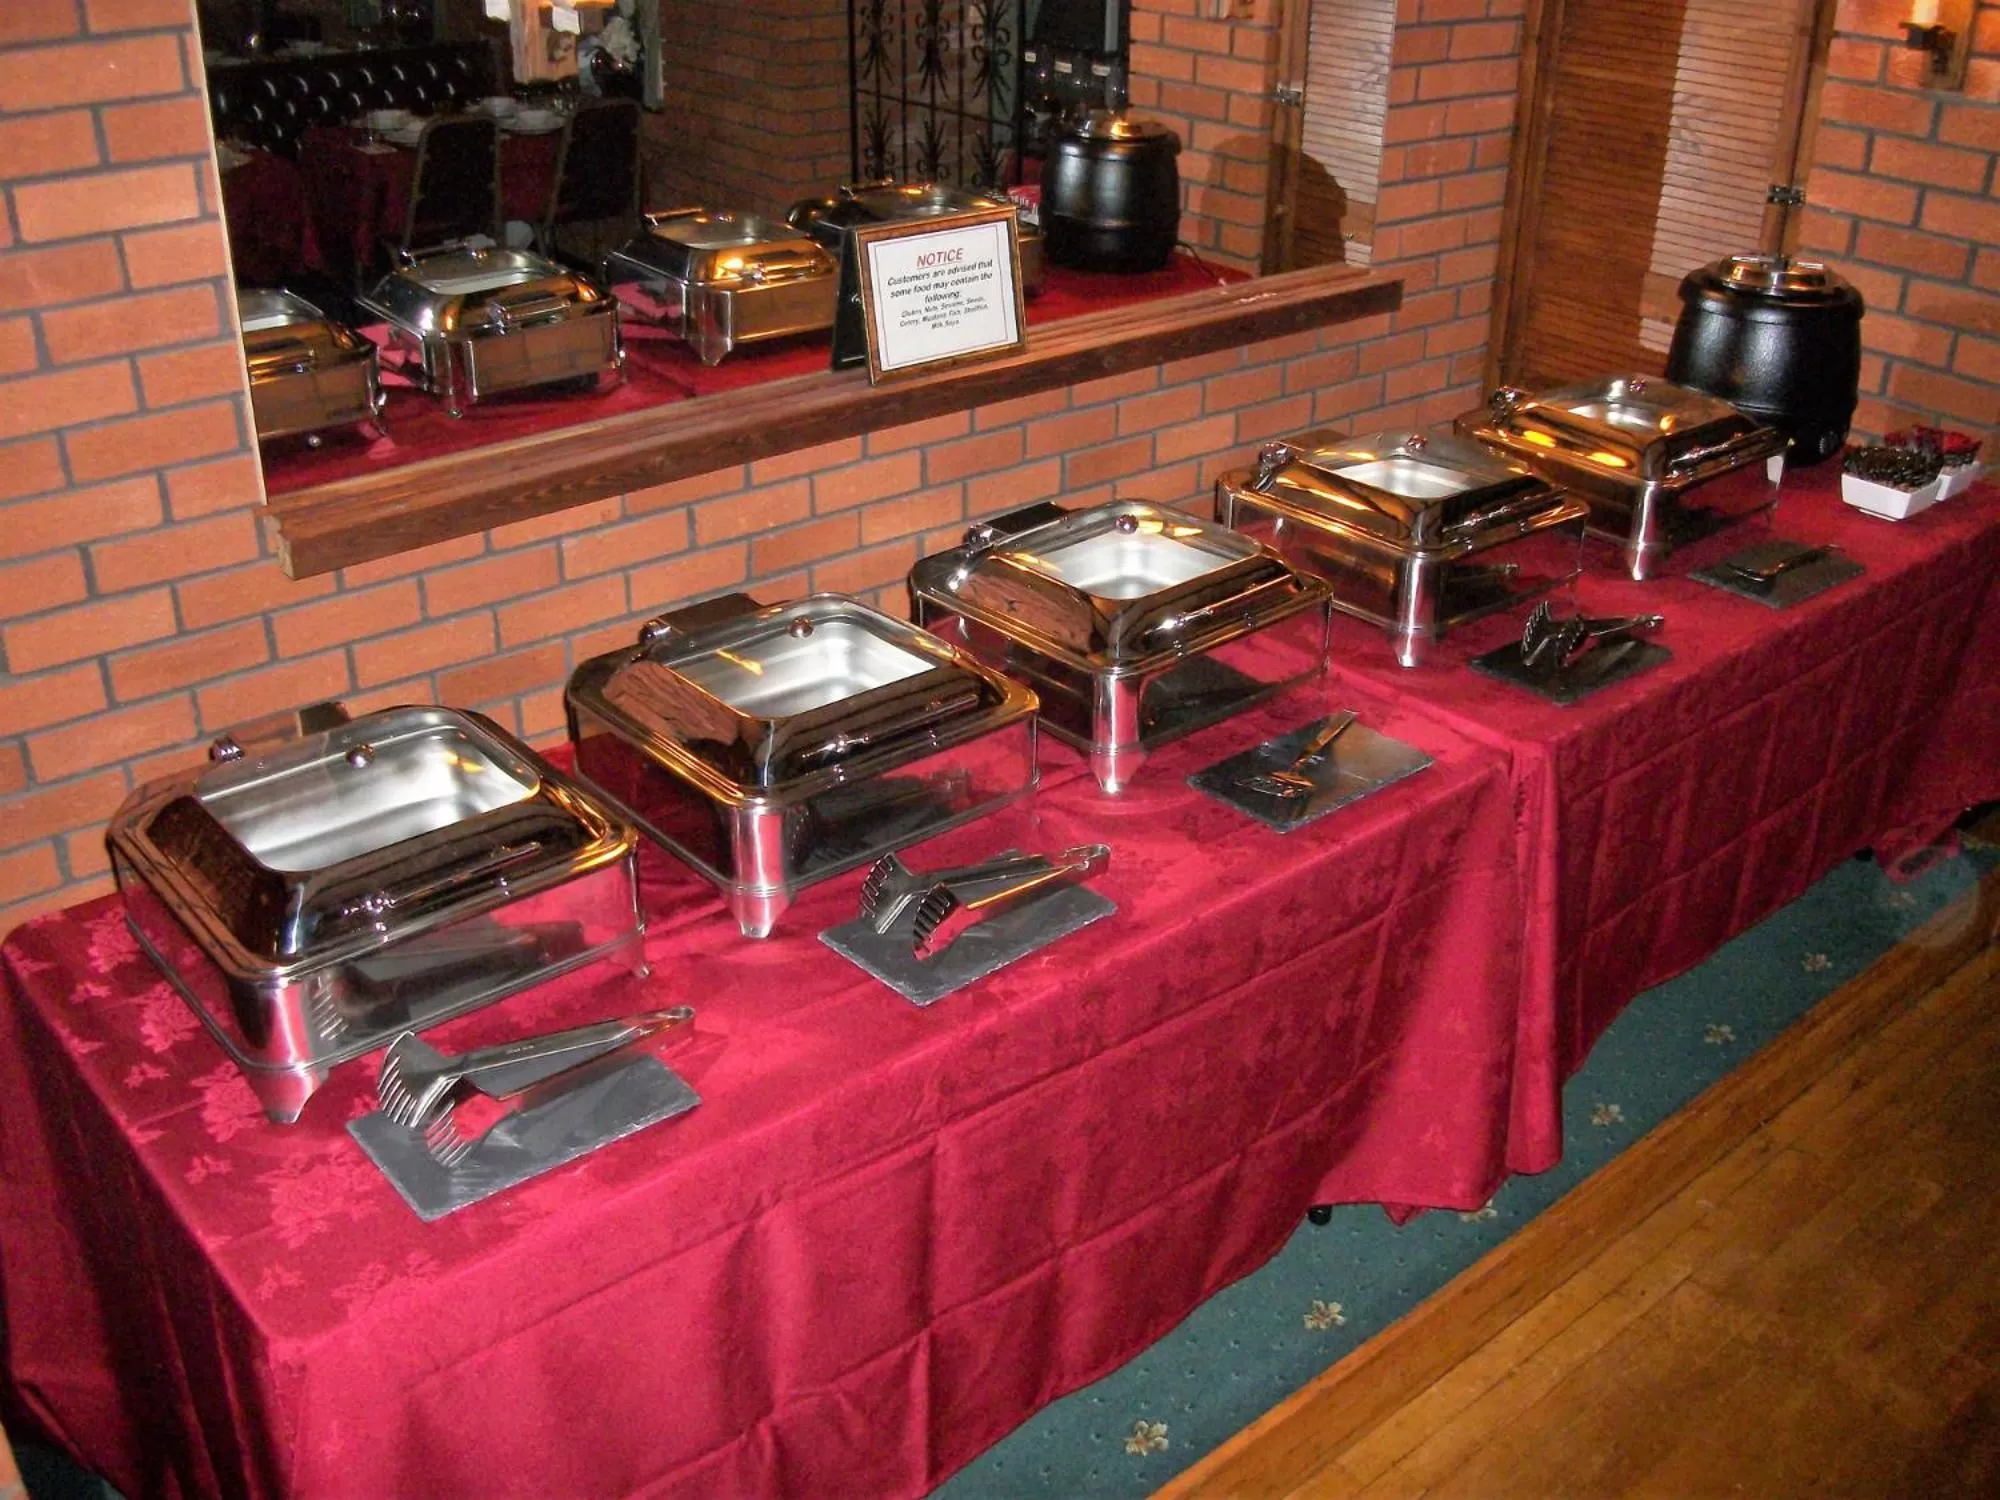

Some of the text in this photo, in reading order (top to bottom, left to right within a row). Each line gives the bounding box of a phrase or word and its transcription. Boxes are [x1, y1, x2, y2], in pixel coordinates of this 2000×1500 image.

[917, 248, 964, 267] NOTICE
[888, 259, 993, 286] Customers are advised that
[890, 271, 993, 298] some food may contain the
